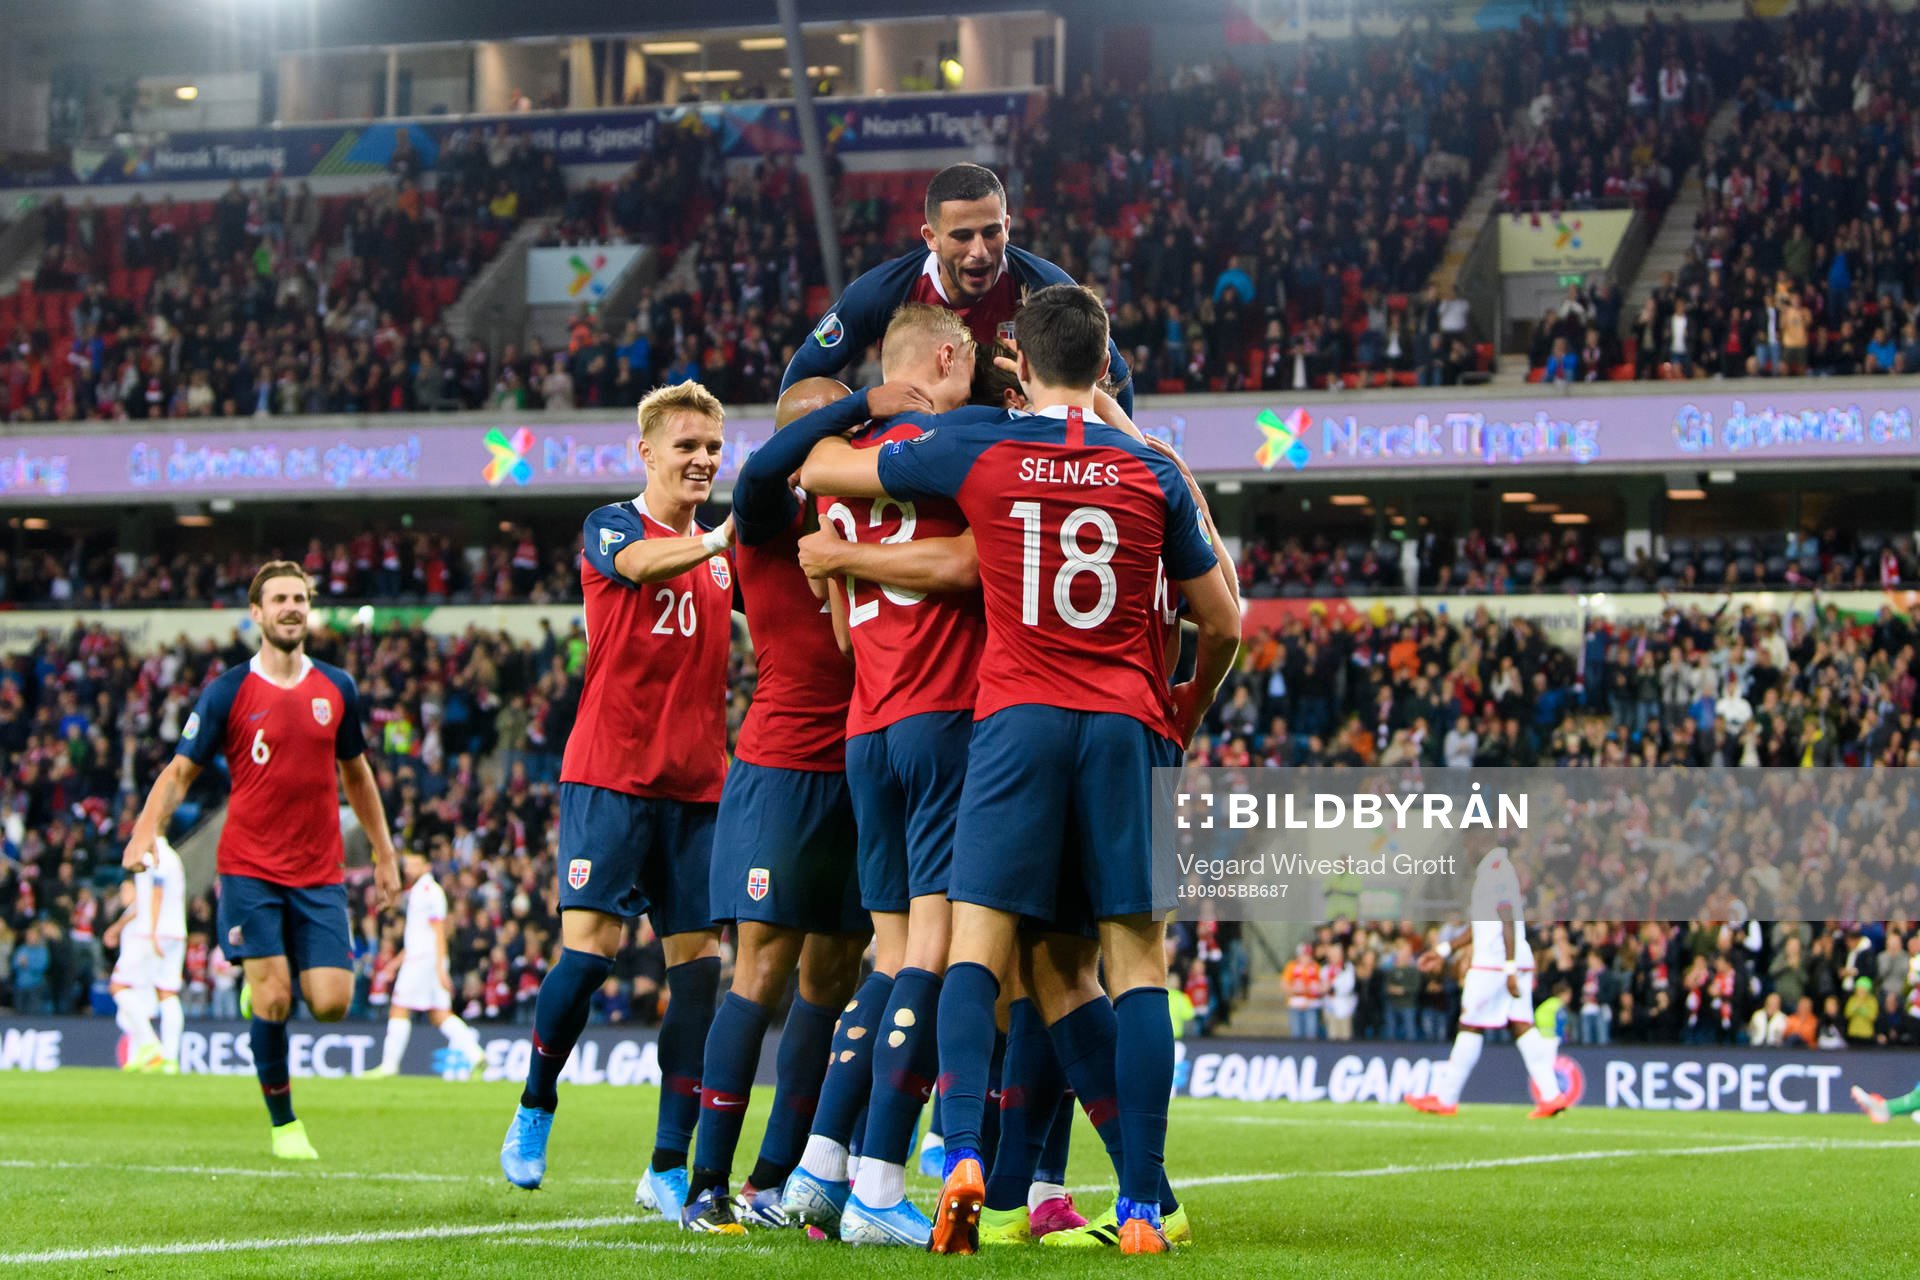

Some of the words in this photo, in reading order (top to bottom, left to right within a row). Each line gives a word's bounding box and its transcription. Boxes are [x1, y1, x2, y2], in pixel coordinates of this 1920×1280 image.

[1322, 414, 1443, 458] Norsk
[1445, 411, 1601, 463] Tipping
[1018, 457, 1120, 487] SELNÆS
[1008, 501, 1119, 630] 18
[651, 588, 697, 637] 20
[251, 728, 271, 765] 6
[180, 1031, 375, 1079] RESECT
[1604, 1060, 1843, 1114] RESPECT
